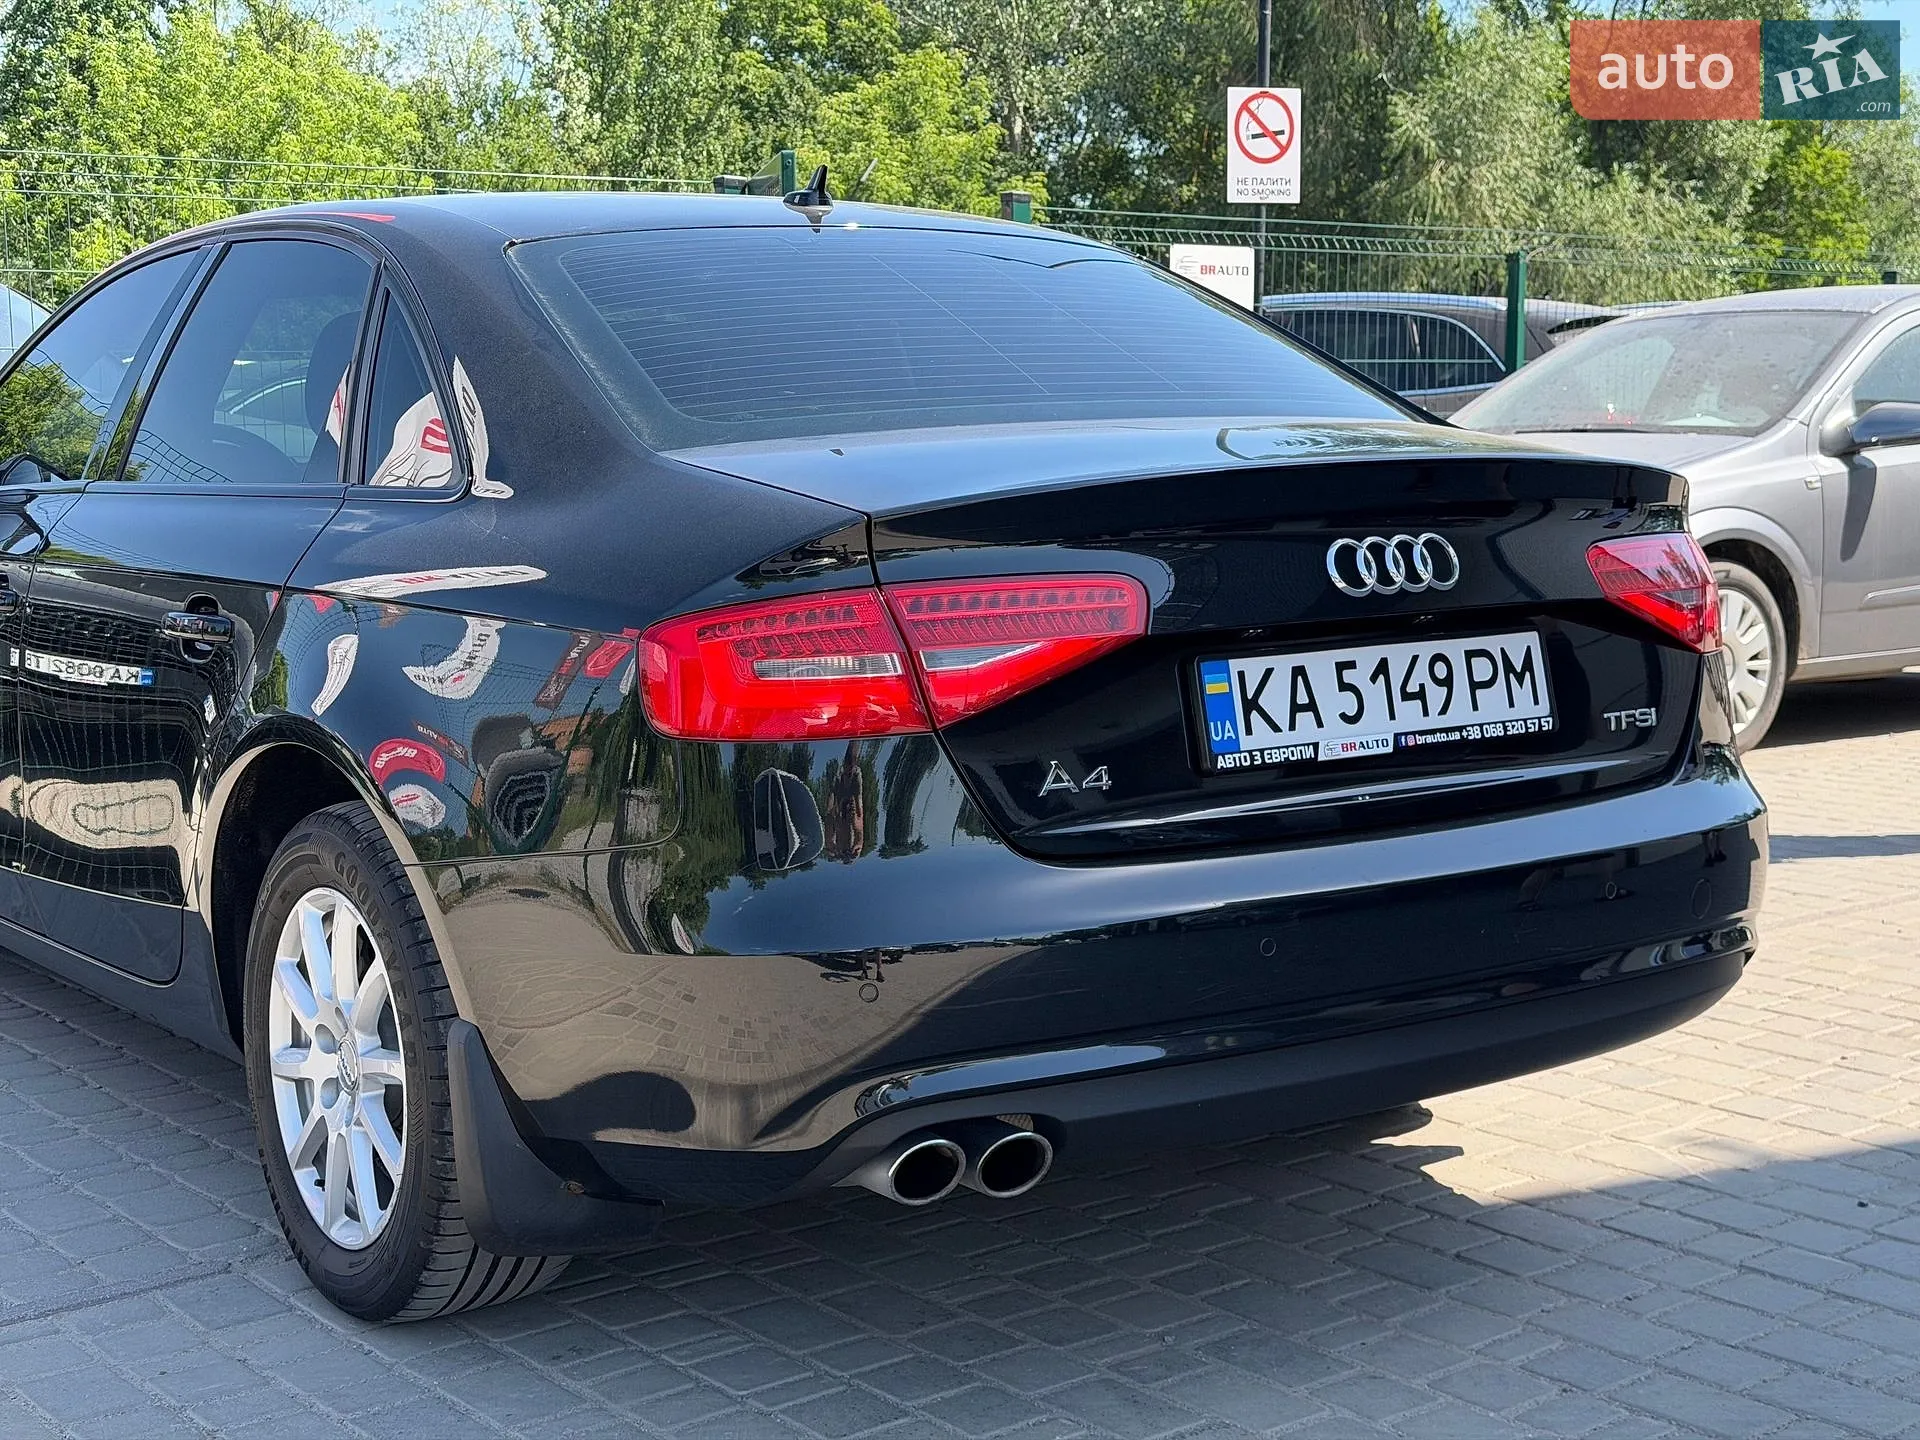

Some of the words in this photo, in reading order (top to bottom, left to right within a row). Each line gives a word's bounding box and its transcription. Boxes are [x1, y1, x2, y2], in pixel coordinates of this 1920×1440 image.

[1236, 177, 1249, 186] НЕ
[1251, 177, 1291, 186] ПАЛИТИ
[1236, 188, 1249, 196] NO
[1251, 188, 1291, 196] SMOKING
[1200, 264, 1249, 276] BRAUTO
[1236, 665, 1325, 737] KA
[1335, 652, 1454, 725] 5149
[1463, 645, 1541, 712] PM
[1603, 707, 1657, 731] TFSI
[1209, 720, 1236, 741] UA
[1416, 731, 1460, 745] brauto.ua
[1462, 725, 1481, 740] +38
[1483, 723, 1504, 738] 068
[1505, 720, 1526, 735] 320
[1527, 719, 1539, 732] 57
[1541, 717, 1553, 731] 57
[1341, 738, 1389, 753] BRAUTO
[1217, 752, 1251, 769] АВТО
[1264, 745, 1315, 764] ЄВРОПИ
[1037, 760, 1112, 797] A4
